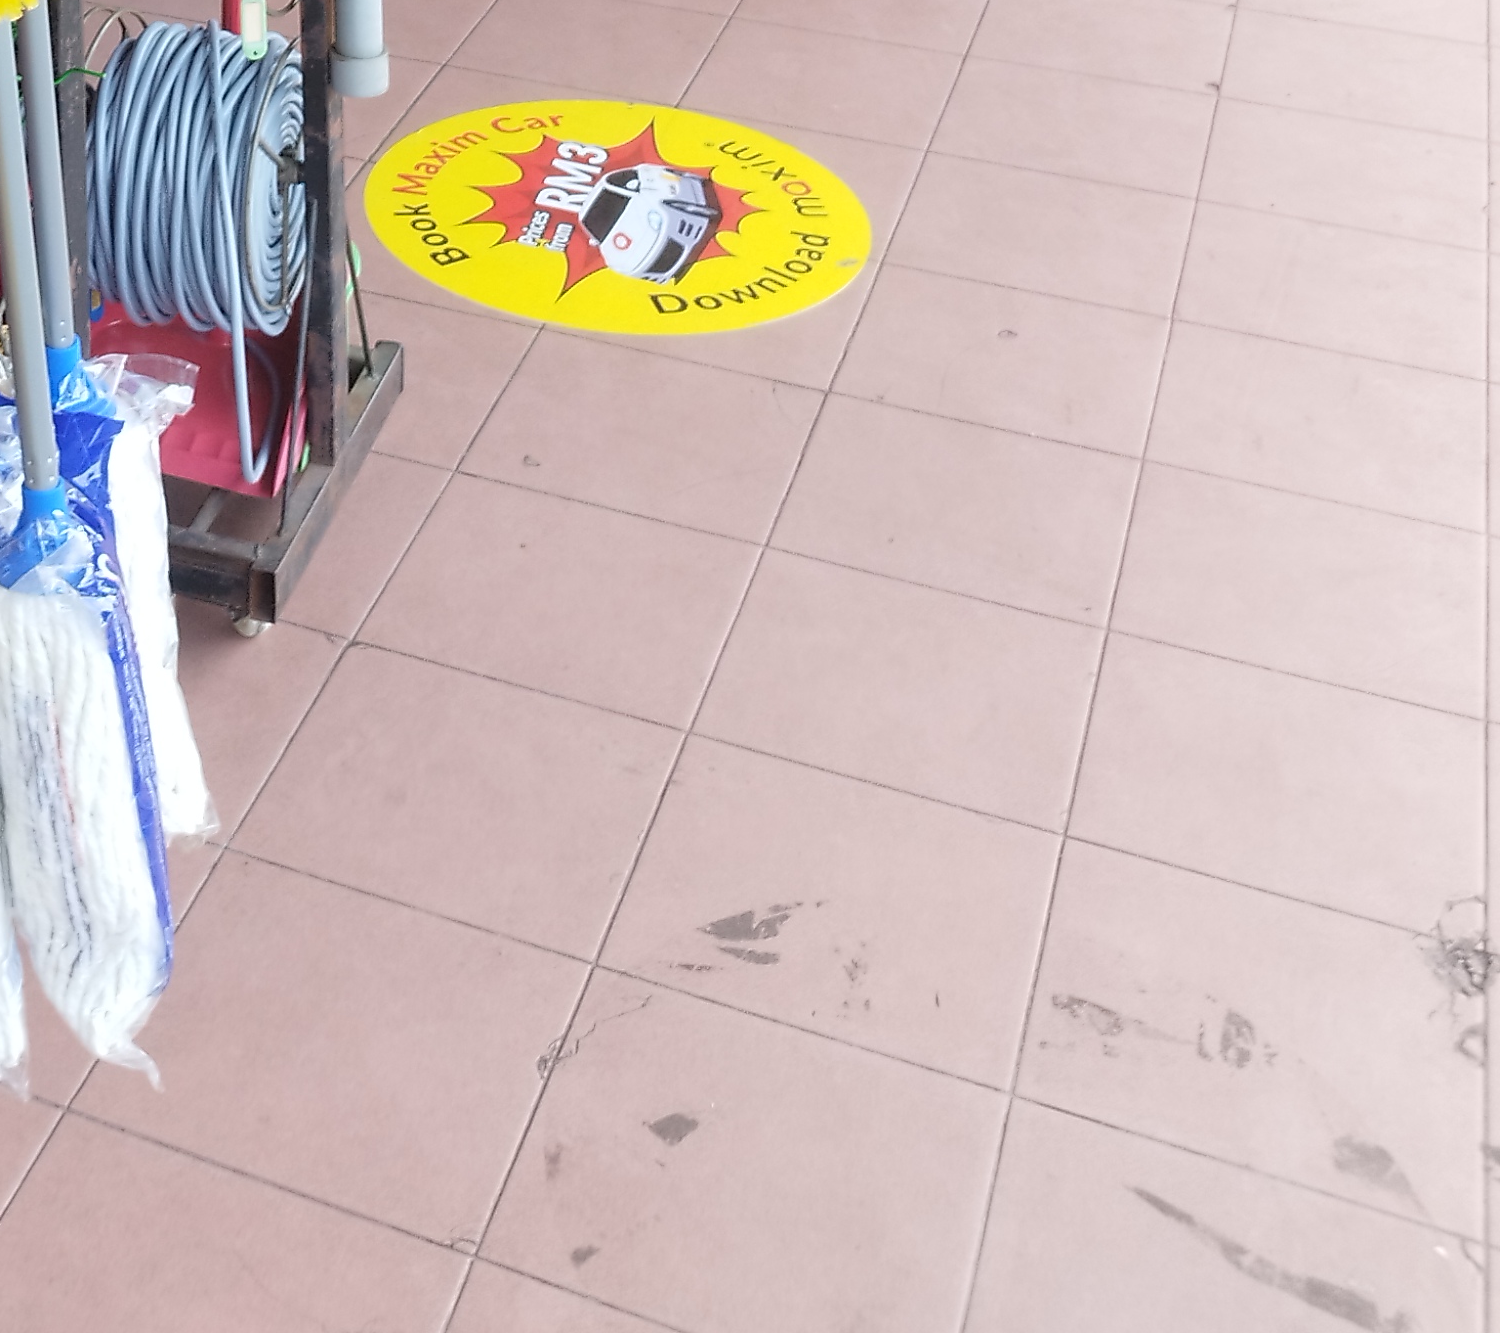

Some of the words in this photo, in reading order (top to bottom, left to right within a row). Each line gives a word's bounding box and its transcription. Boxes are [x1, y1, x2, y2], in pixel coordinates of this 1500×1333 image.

[490, 113, 564, 133] Car
[392, 130, 489, 195] Maxim
[534, 140, 609, 213] RM3
[394, 203, 472, 266] Book
[518, 210, 550, 247] Prices
[650, 230, 830, 314] Download
